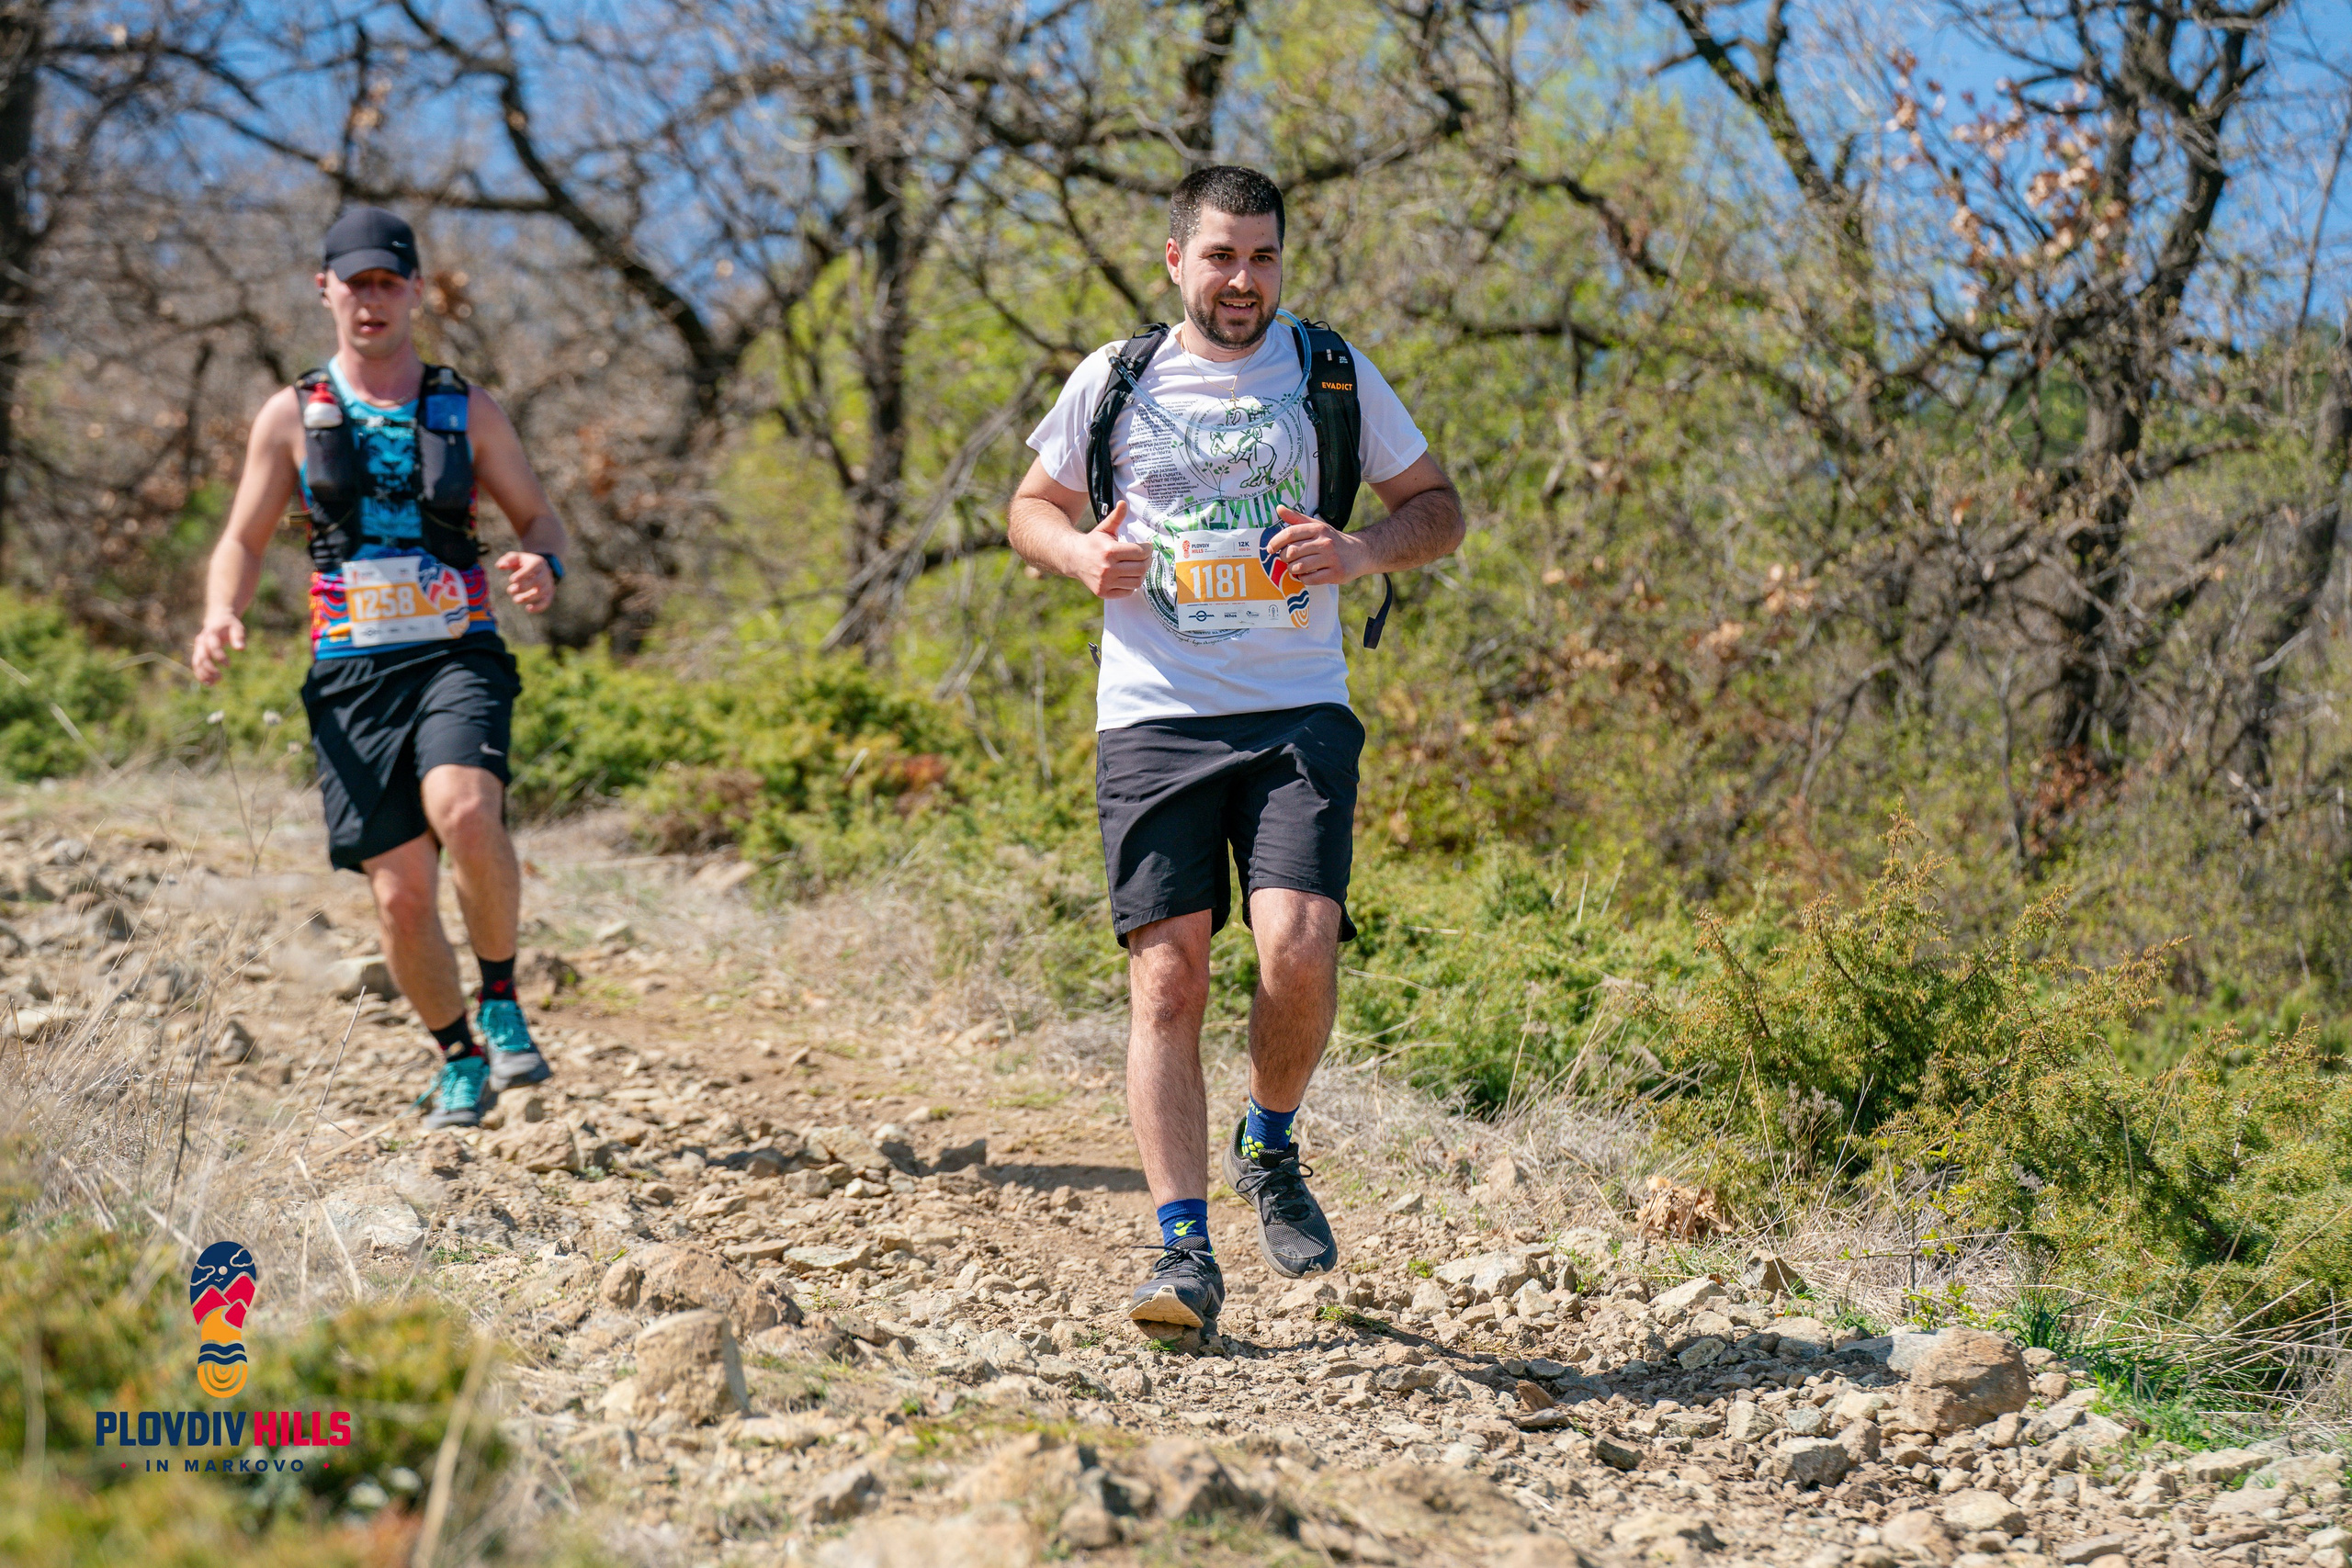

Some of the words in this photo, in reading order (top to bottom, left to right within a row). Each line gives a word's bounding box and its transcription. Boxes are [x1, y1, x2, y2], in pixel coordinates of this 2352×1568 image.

[1321, 381, 1353, 391] EVADICT
[1190, 563, 1247, 599] 1181
[352, 585, 416, 620] 1258
